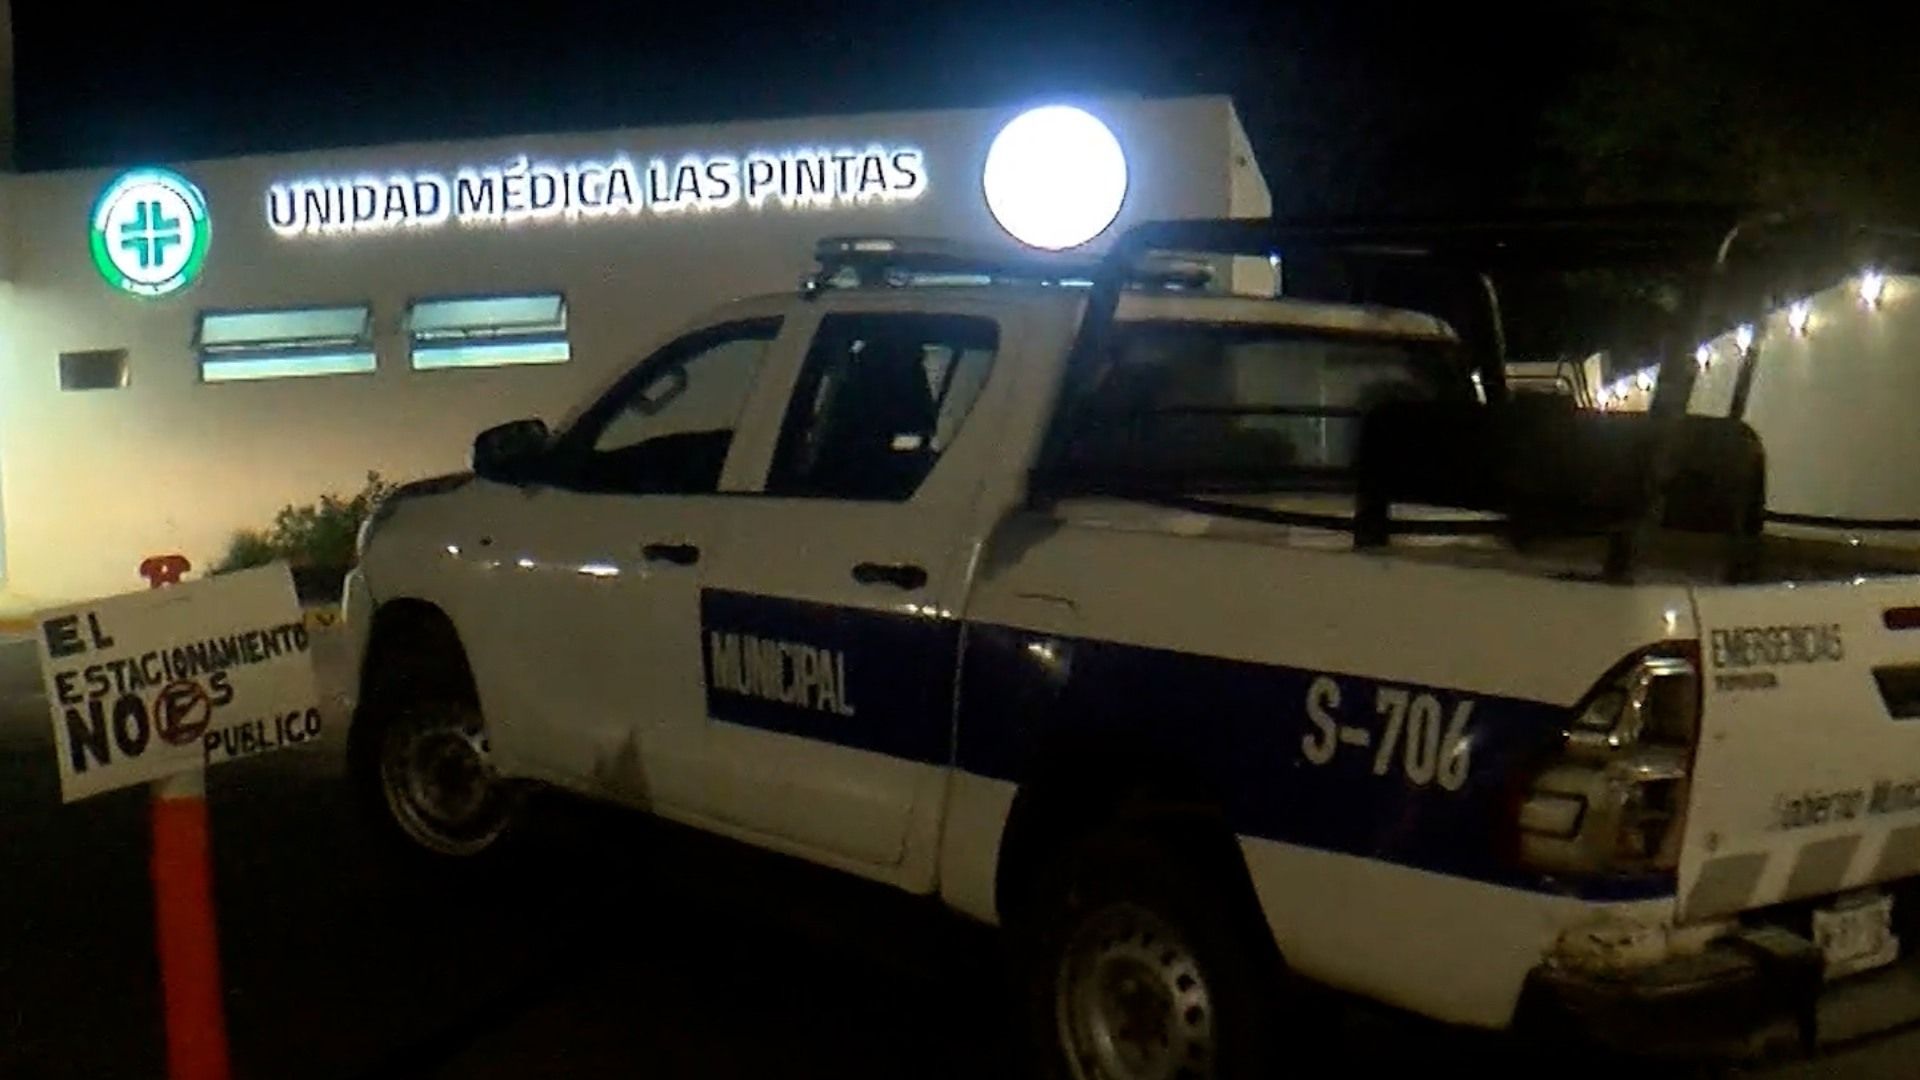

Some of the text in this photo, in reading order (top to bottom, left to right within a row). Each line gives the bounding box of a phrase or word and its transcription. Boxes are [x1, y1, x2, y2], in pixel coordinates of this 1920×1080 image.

[269, 153, 917, 227] UNIDAD MÉDICA LAS PINTAS
[43, 612, 113, 658] EL
[55, 622, 308, 704] ESTACIONAMIENTO
[711, 631, 855, 716] MUNICIPAL
[65, 694, 149, 773] NO
[204, 707, 321, 766] PUBLICO
[1302, 676, 1475, 791] S-706
